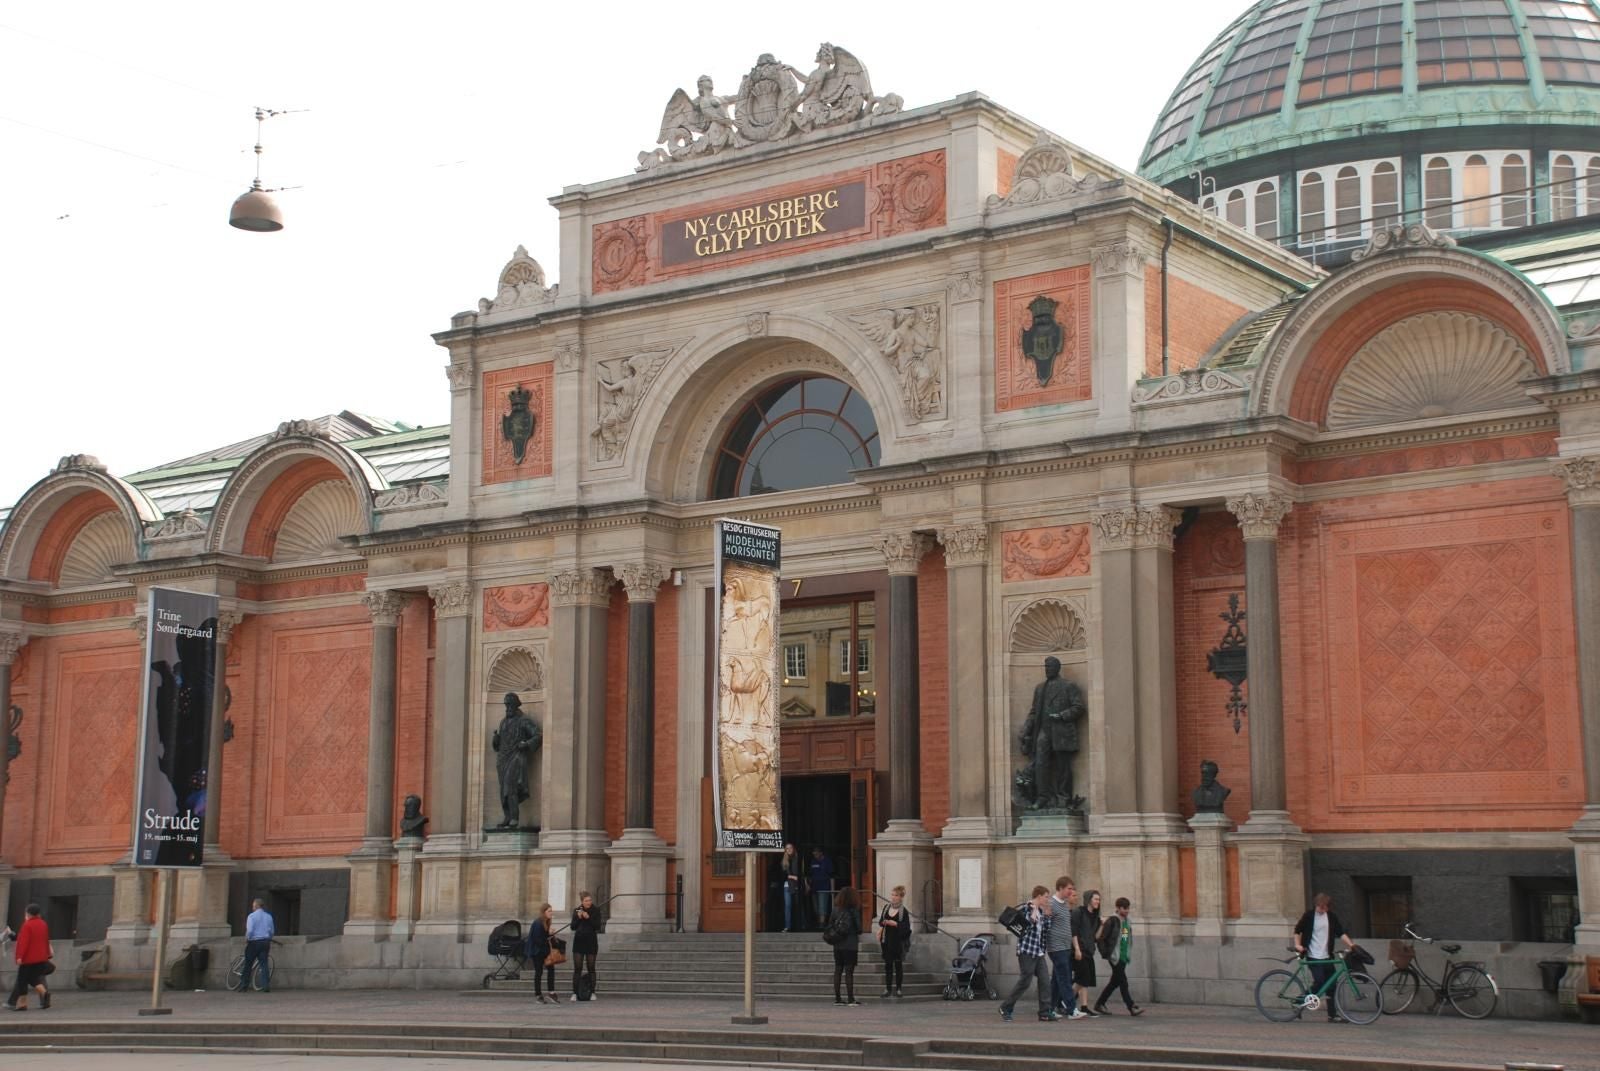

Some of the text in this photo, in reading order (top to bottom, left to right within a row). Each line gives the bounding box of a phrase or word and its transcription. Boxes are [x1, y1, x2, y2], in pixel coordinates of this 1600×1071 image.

[685, 190, 838, 238] NY-CARLSBERG
[695, 212, 827, 257] GLYPTOTEK
[744, 526, 779, 539] ETRUSKERNE
[726, 534, 776, 551] MIDDELHAVS
[726, 544, 775, 560] HORISONTEN
[791, 579, 801, 597] 7
[157, 608, 182, 622] Trine
[156, 621, 213, 639] Søndergaard
[144, 808, 200, 831] Strude
[186, 835, 197, 843] maj
